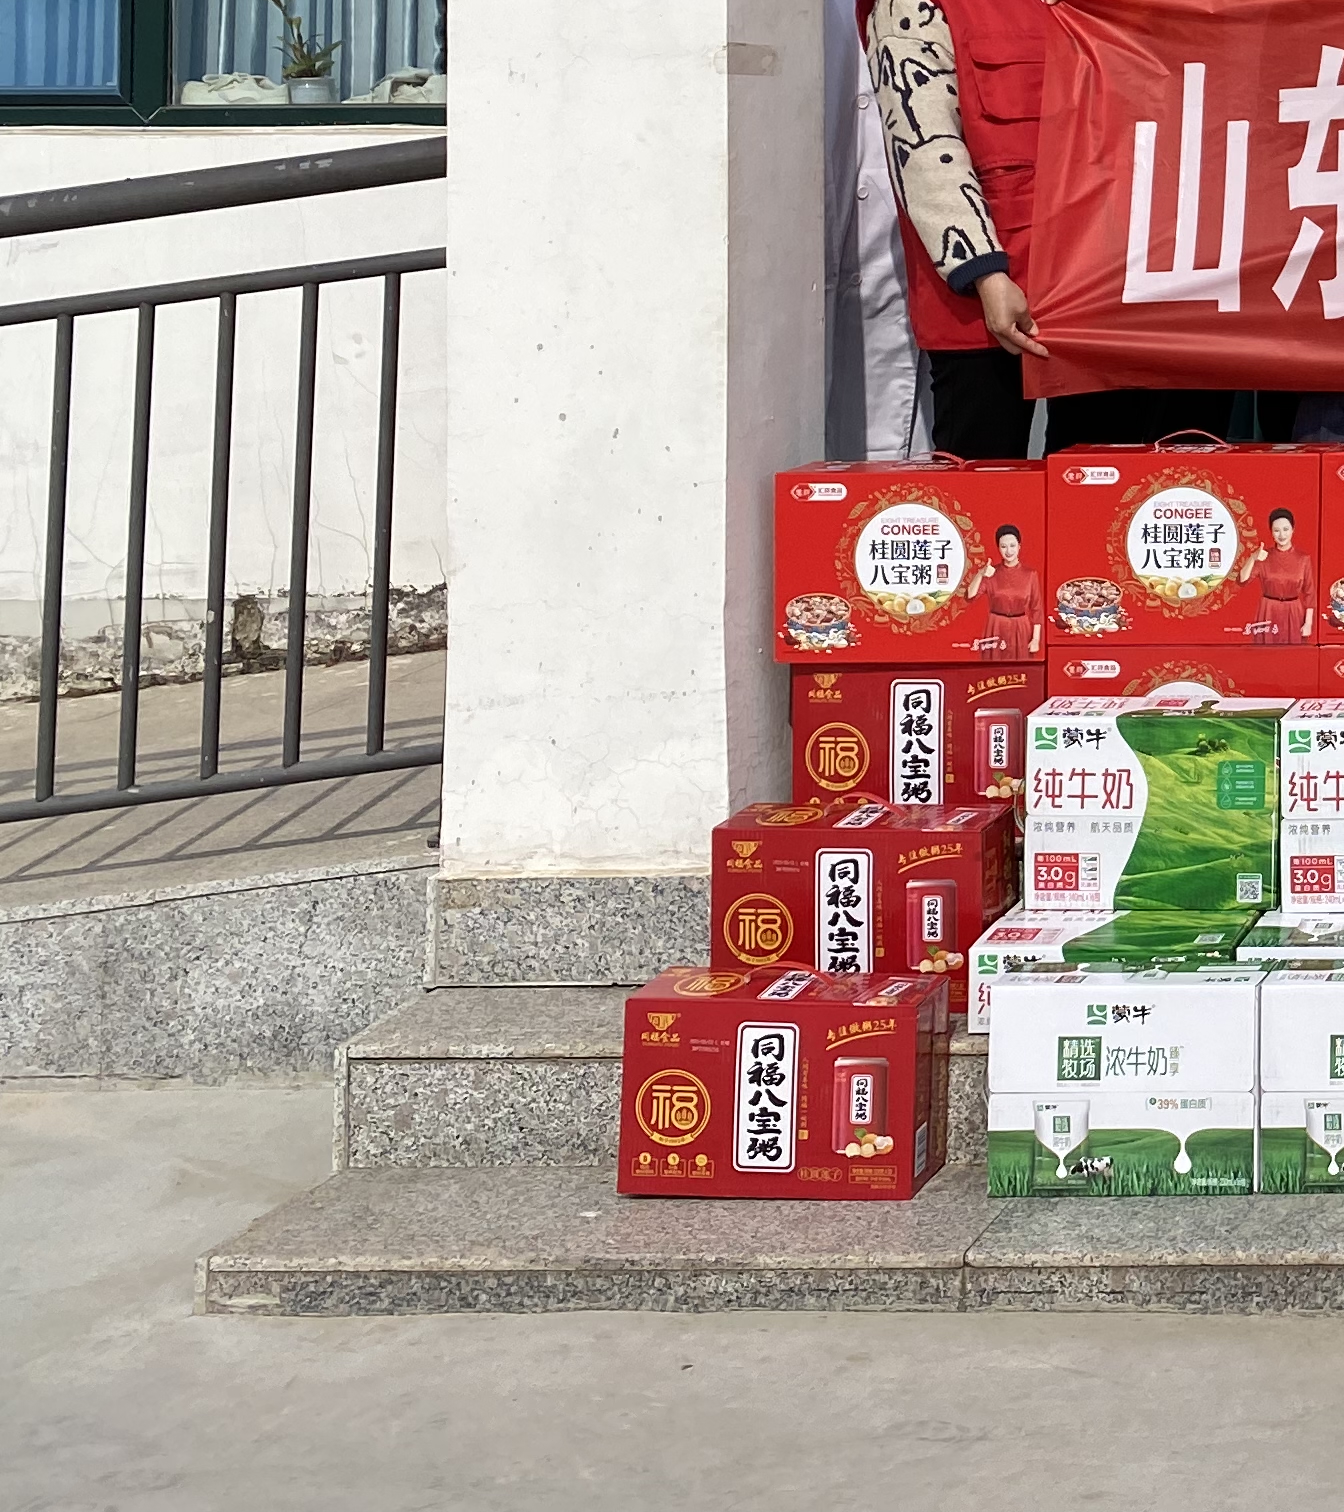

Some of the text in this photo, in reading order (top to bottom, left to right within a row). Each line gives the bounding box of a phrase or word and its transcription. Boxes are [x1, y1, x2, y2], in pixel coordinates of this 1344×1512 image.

[1153, 508, 1213, 519] CONGEE
[881, 525, 940, 535] CONGEE
[1141, 523, 1225, 544] 桂圆莲子
[869, 540, 952, 561] 桂圆莲子
[1141, 547, 1204, 569] 八宝粥
[870, 564, 932, 586] 八宝粥
[900, 689, 935, 803] 同福八宝粥
[1062, 728, 1107, 749] 蒙牛
[818, 737, 859, 777] 福
[1033, 768, 1133, 809] 纯牛奶
[826, 858, 864, 973] 同福八宝粥
[738, 908, 781, 950] 福
[1112, 1005, 1152, 1024] 蒙牛
[1105, 1046, 1167, 1076] 浓牛奶
[652, 1085, 699, 1129] 福
[747, 1033, 788, 1162] 同福八宝粥
